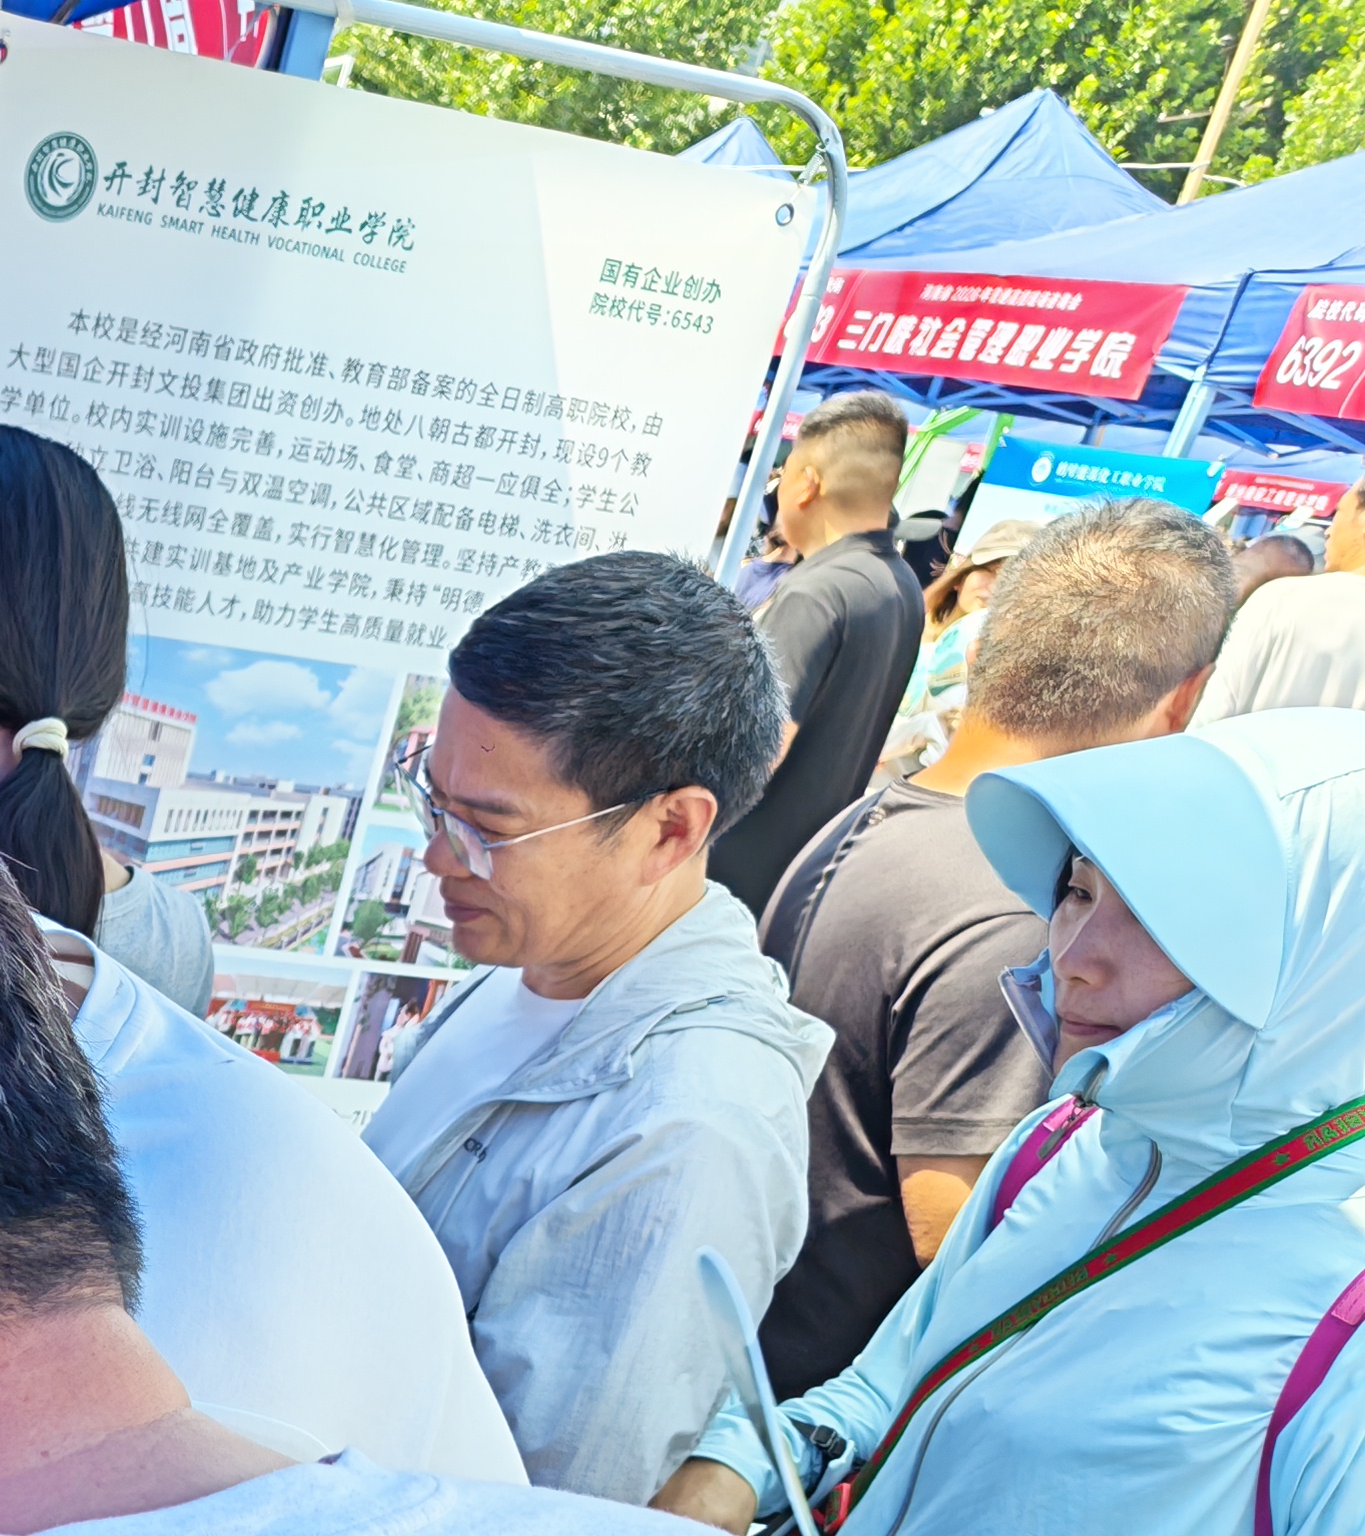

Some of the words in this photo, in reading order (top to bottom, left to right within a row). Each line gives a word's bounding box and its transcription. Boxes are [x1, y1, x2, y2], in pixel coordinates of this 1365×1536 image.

[96, 203, 153, 227] KAIFENG
[160, 213, 204, 236] SMART
[210, 224, 261, 247] HEALTH
[267, 235, 345, 263] VOCATIONAL
[353, 252, 407, 274] COLLEGE
[103, 161, 417, 253] 开封智慧健康职业学院
[599, 258, 722, 304] 国有企业创办
[1275, 335, 1362, 390] 6392
